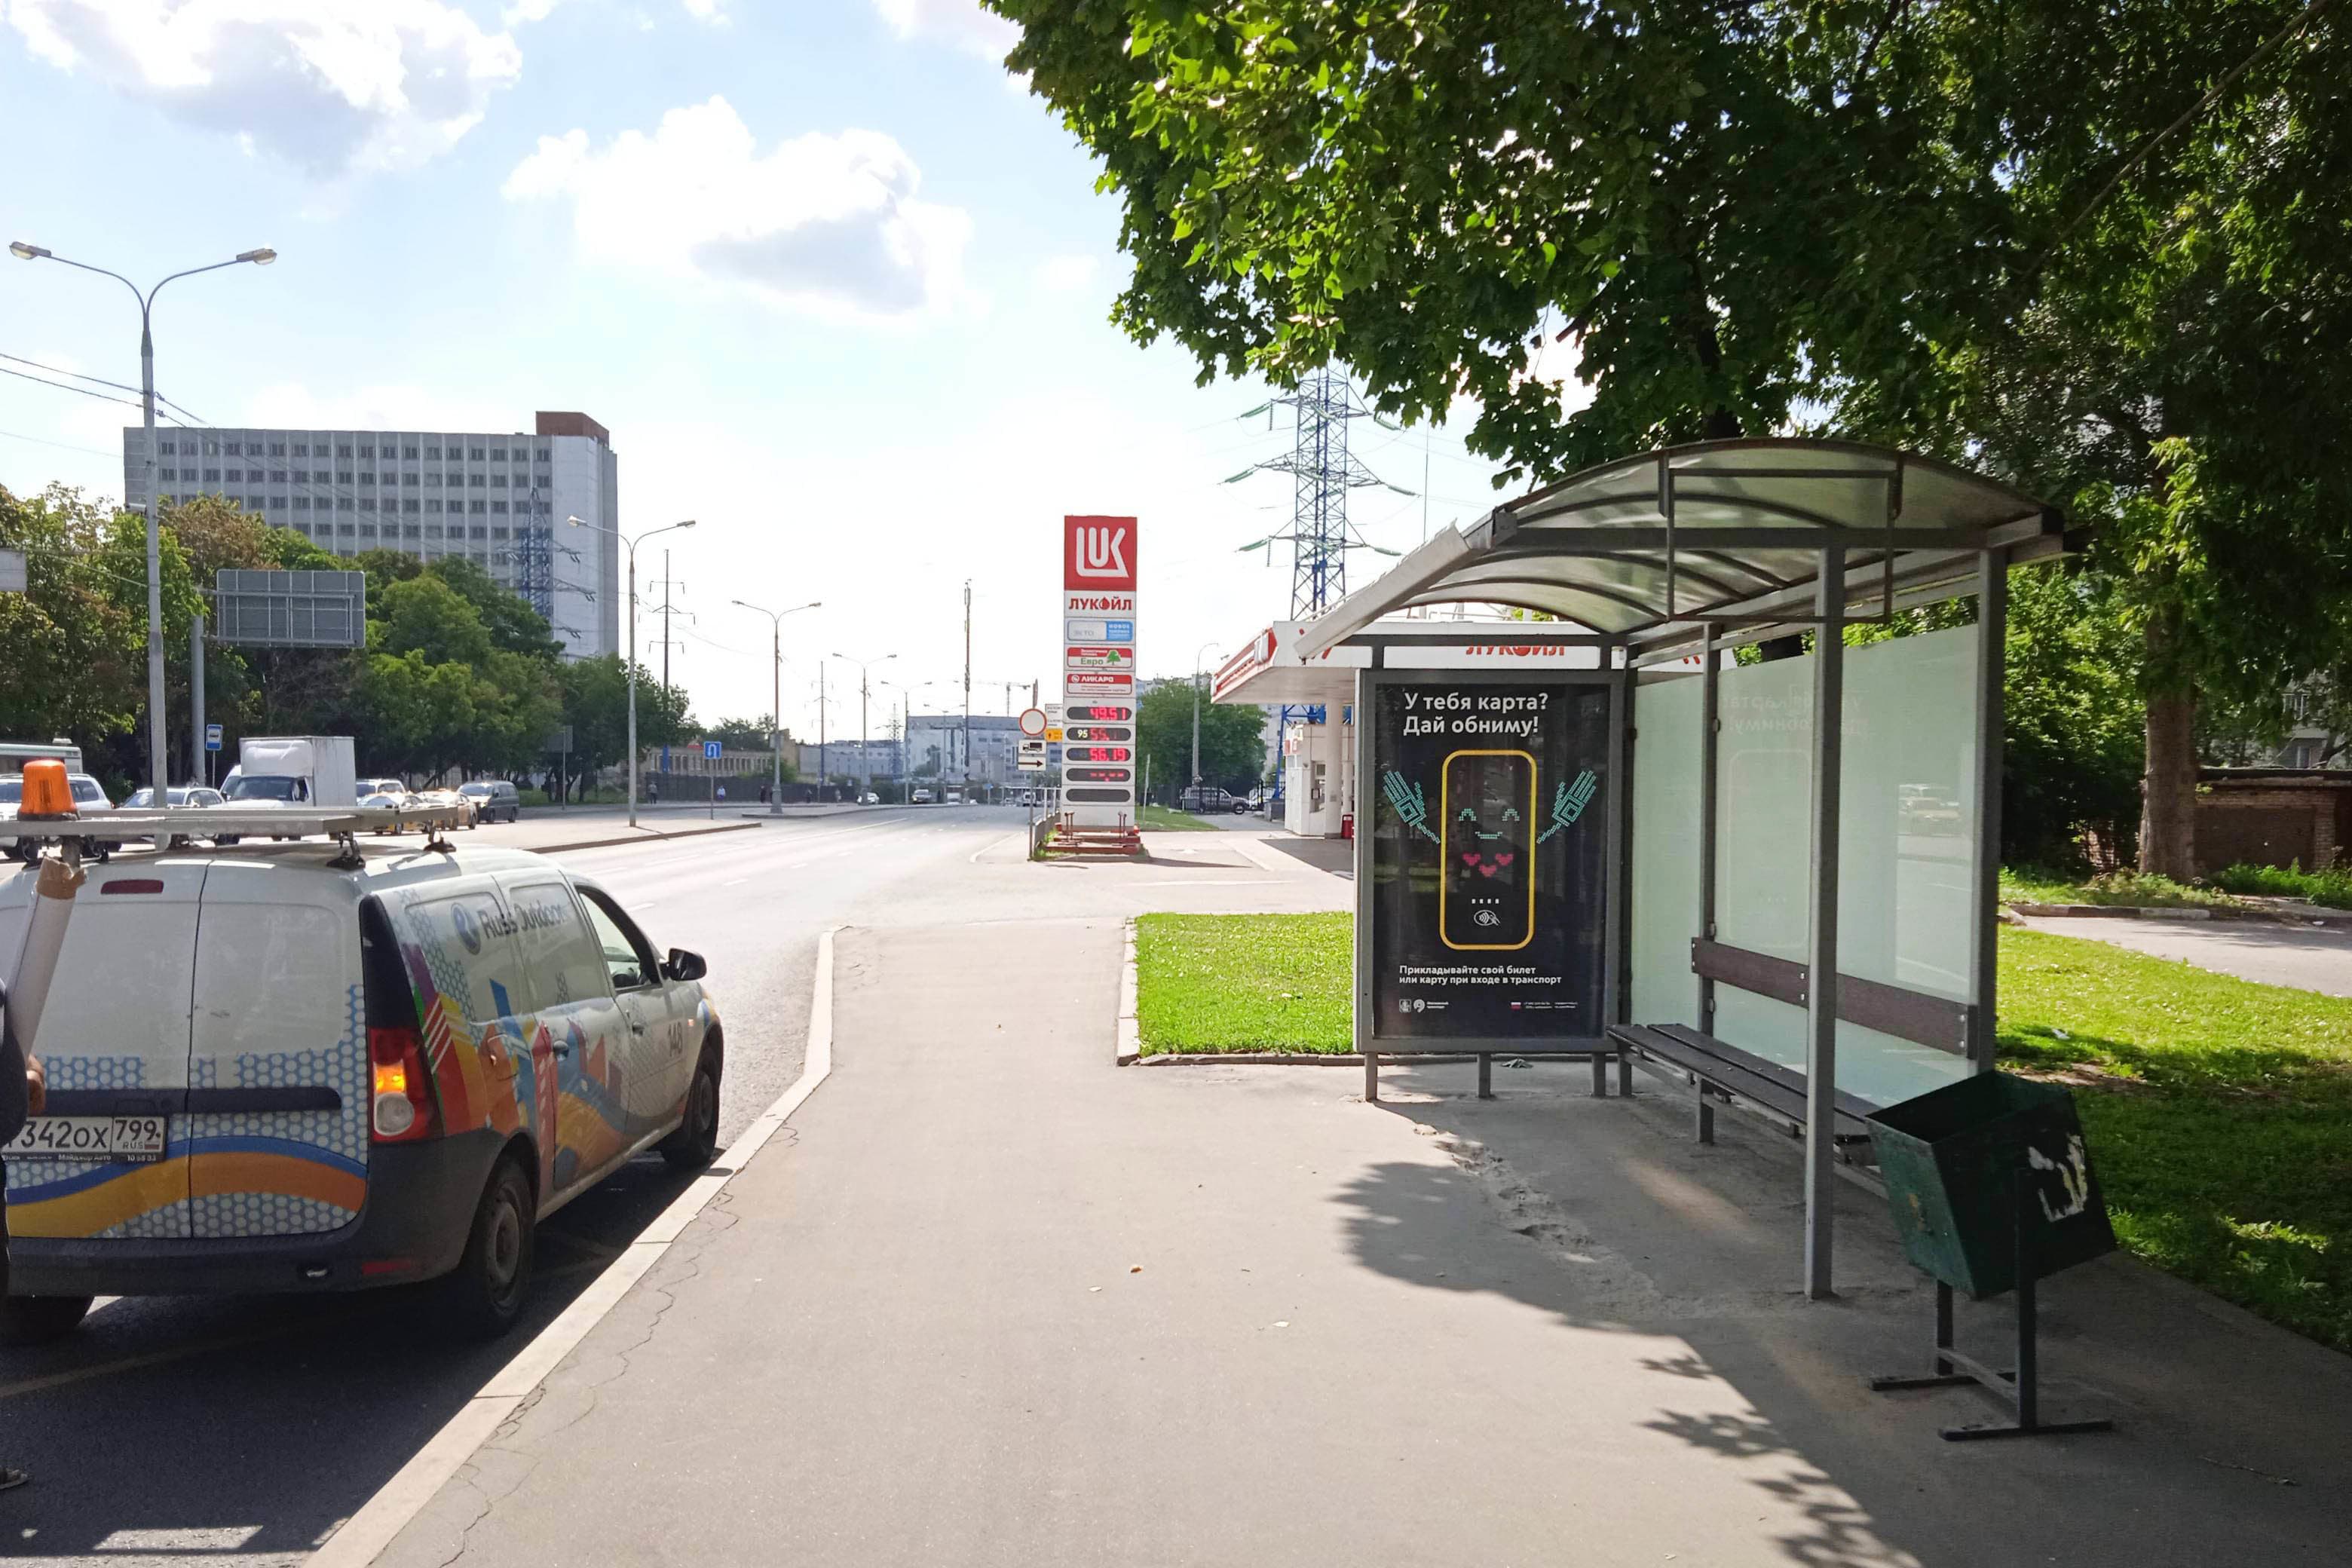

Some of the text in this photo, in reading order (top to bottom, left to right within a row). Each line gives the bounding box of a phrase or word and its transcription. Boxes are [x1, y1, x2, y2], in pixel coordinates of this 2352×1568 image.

[1068, 596, 1132, 611] ЛУКОЙЛ
[1080, 657, 1104, 666] Евро
[1404, 692, 1548, 714] У тебя карта?
[1403, 716, 1539, 737] Дай обниму!
[1077, 729, 1088, 738] 95
[1399, 965, 1536, 975] Прикладывайте свой билет
[1419, 976, 1447, 985] карту
[1450, 976, 1468, 985] при
[1471, 976, 1500, 985] входе
[1510, 976, 1562, 985] транспорт
[8, 1119, 157, 1148] 342OX 799
